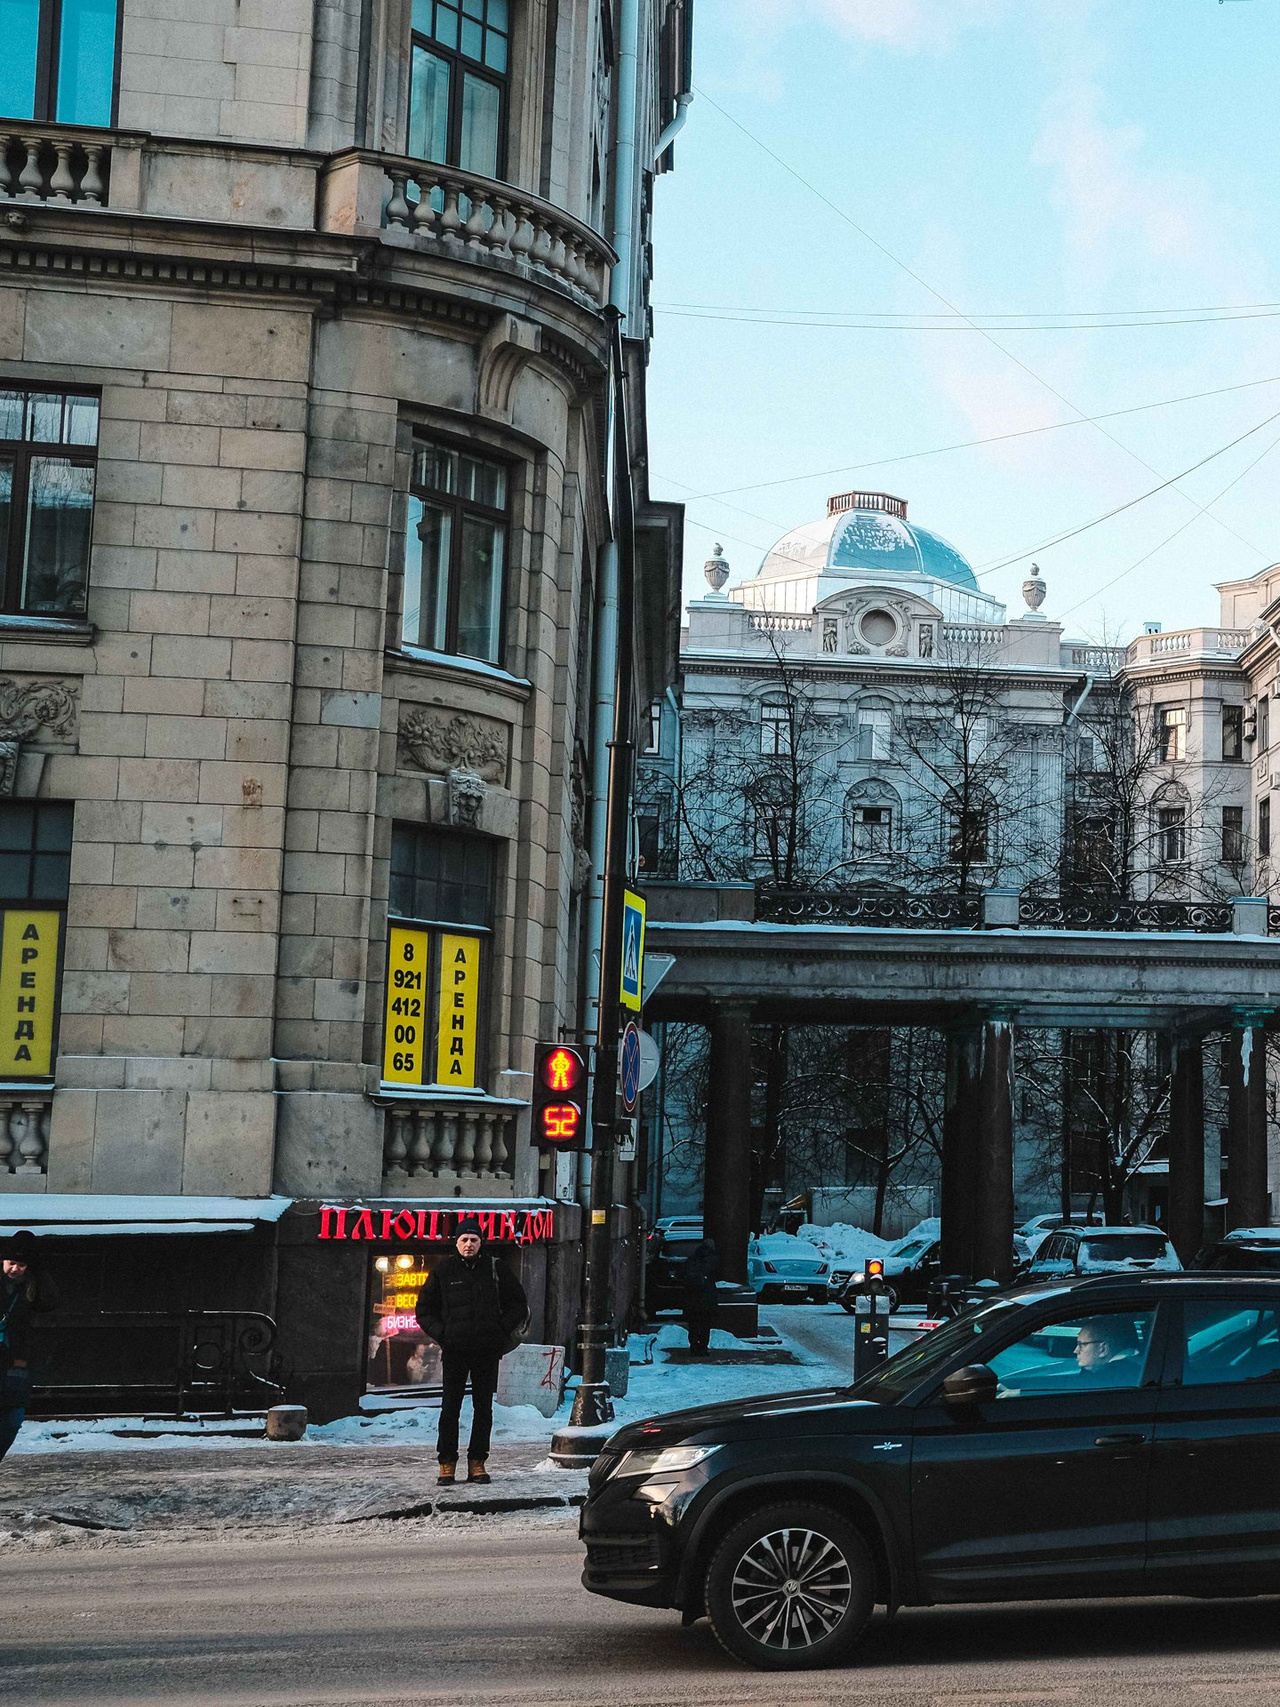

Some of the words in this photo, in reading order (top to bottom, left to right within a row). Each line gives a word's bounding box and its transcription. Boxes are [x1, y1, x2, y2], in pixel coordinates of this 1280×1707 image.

[403, 943, 414, 962] 8
[394, 969, 422, 990] 921
[14, 923, 40, 1061] АРЕНДА
[391, 997, 421, 1017] 412
[450, 948, 467, 1075] АРЕНДА
[394, 1024, 416, 1044] 00
[393, 1052, 414, 1072] 65
[544, 1106, 577, 1136] 52
[397, 1273, 430, 1286] ЗАВТР
[387, 1315, 421, 1329] БИЗНЕ
